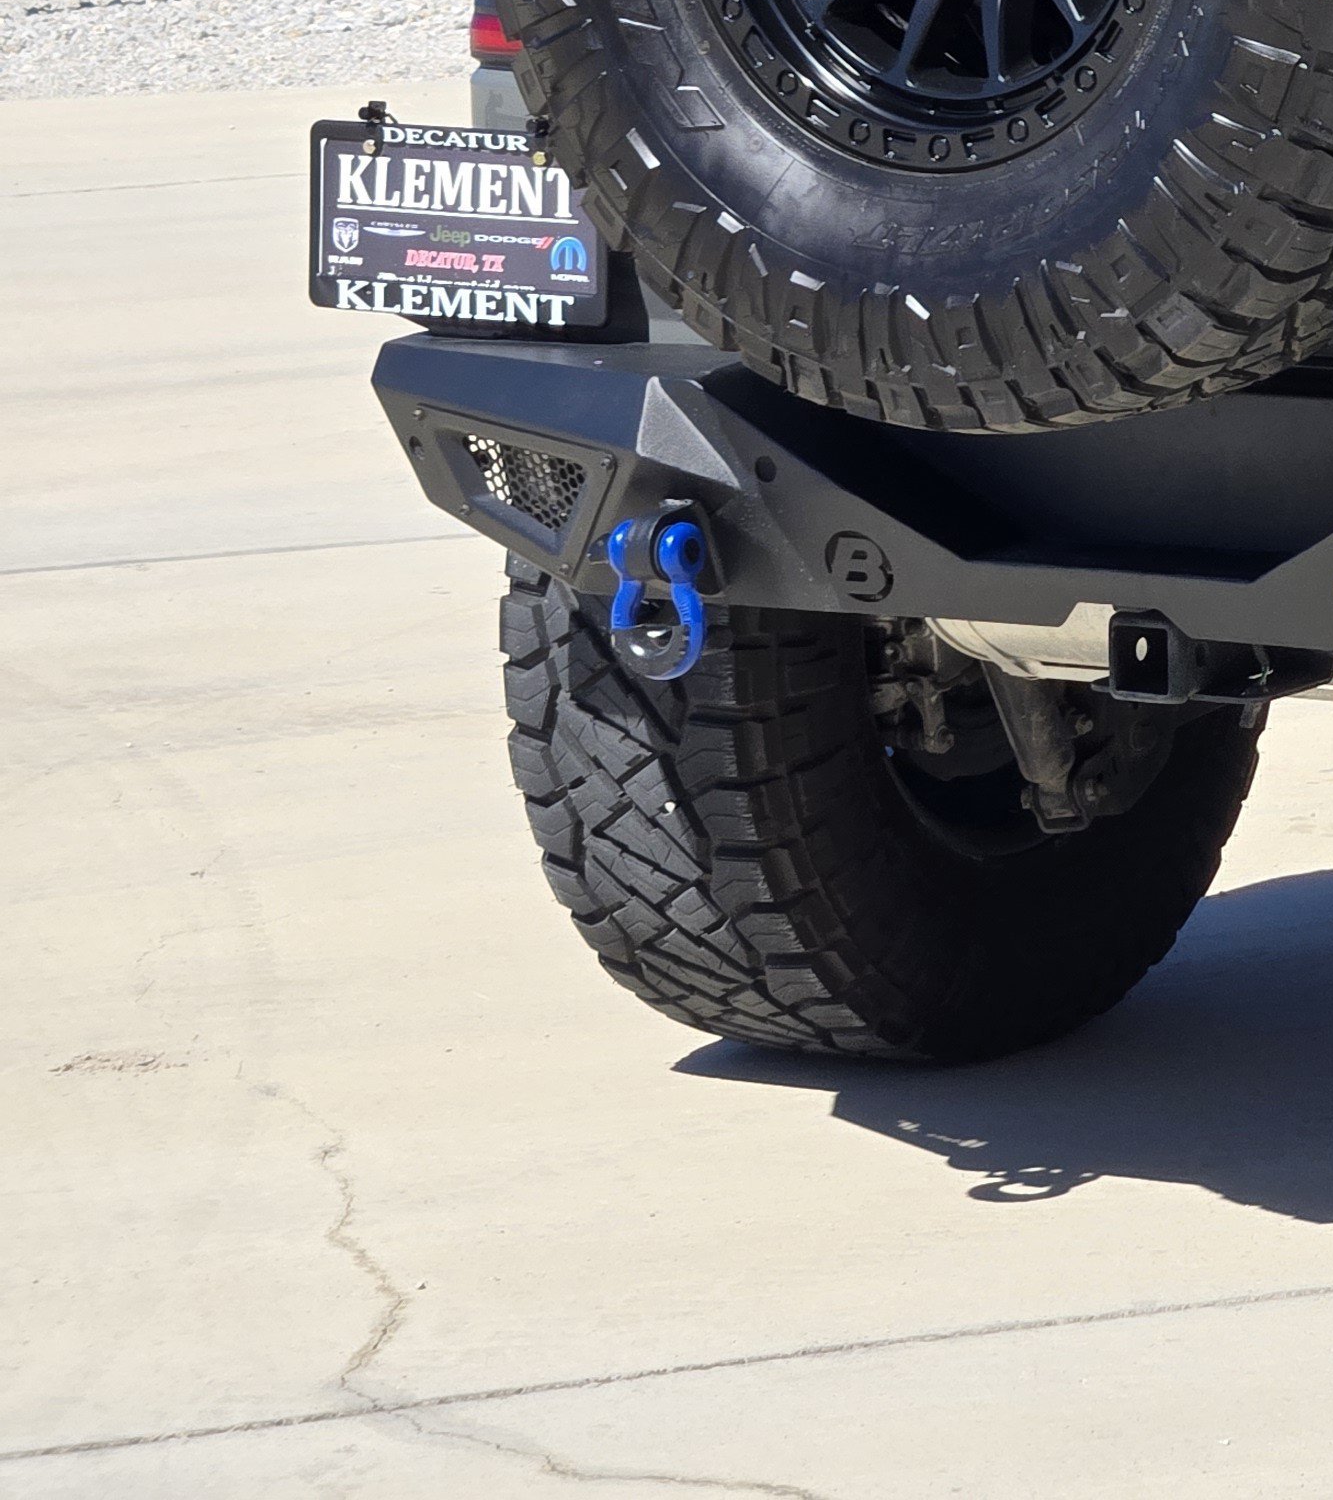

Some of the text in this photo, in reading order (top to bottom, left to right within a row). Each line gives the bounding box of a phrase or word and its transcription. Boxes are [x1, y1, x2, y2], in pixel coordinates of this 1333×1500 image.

[382, 126, 530, 152] DECATUR
[336, 153, 573, 218] KLEMENT
[429, 224, 472, 248] Jeep
[473, 233, 545, 246] DODGE
[336, 279, 575, 327] KLEMENT
